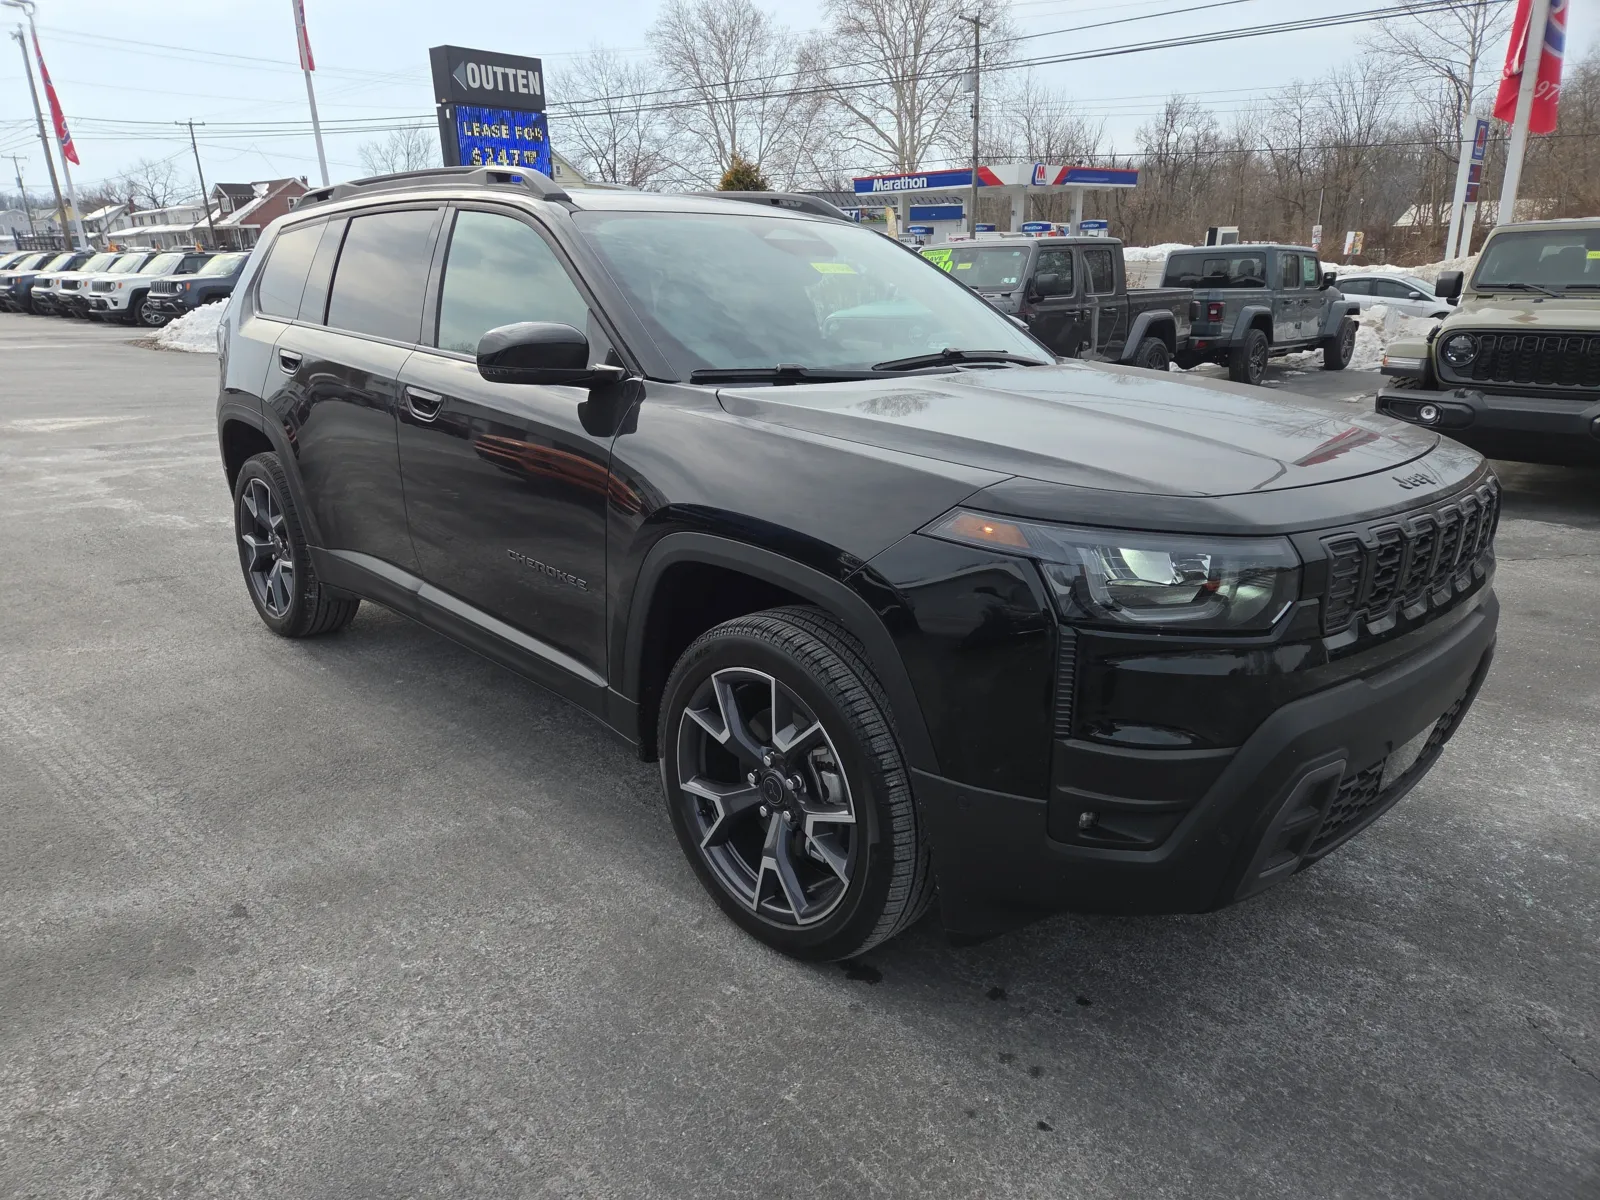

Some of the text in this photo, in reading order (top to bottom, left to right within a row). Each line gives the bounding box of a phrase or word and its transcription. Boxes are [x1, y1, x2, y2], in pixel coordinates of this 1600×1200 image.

[466, 62, 541, 95] OUTTEN
[464, 122, 543, 141] LEASE FOR
[472, 147, 520, 166] $247
[873, 177, 927, 191] Marathon
[1392, 473, 1436, 490] Jeep
[507, 549, 588, 591] CHEROKEE
